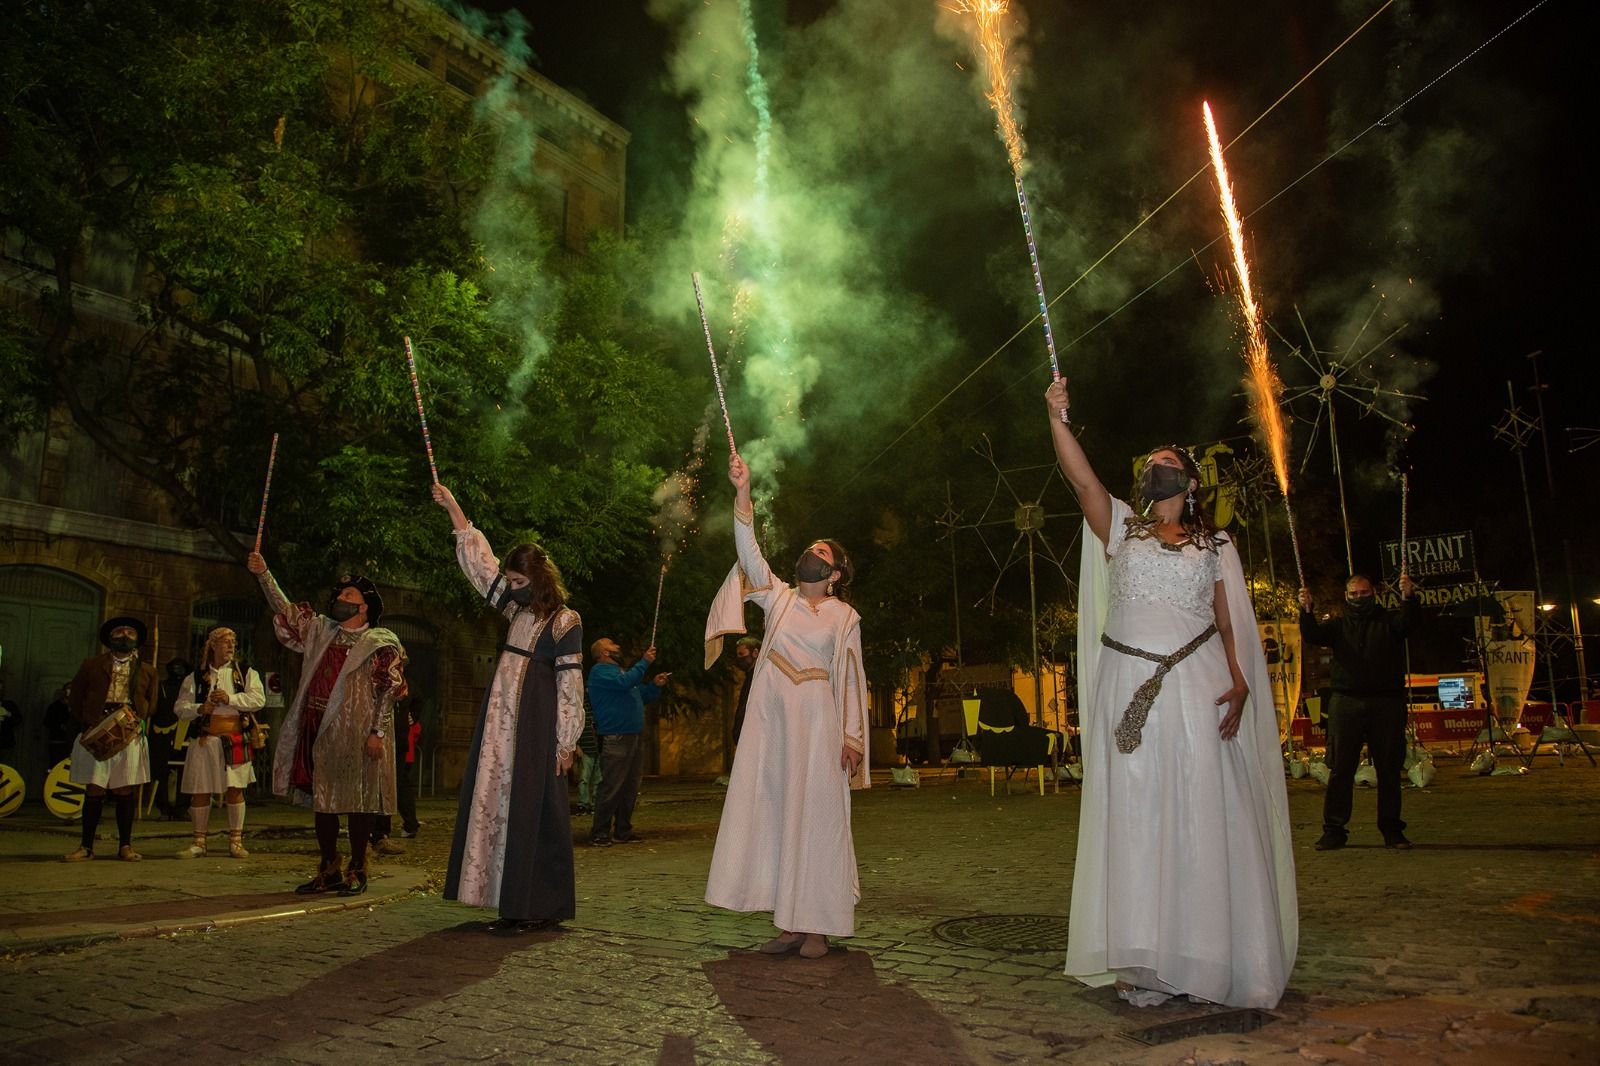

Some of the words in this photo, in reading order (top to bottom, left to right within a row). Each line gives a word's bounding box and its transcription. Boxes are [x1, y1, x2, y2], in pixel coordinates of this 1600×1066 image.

[1386, 534, 1466, 566] TRANT
[1418, 560, 1461, 576] LLETRA
[1413, 582, 1491, 606] ORDANA
[1269, 672, 1296, 684] RANT
[1443, 718, 1484, 729] Mahou
